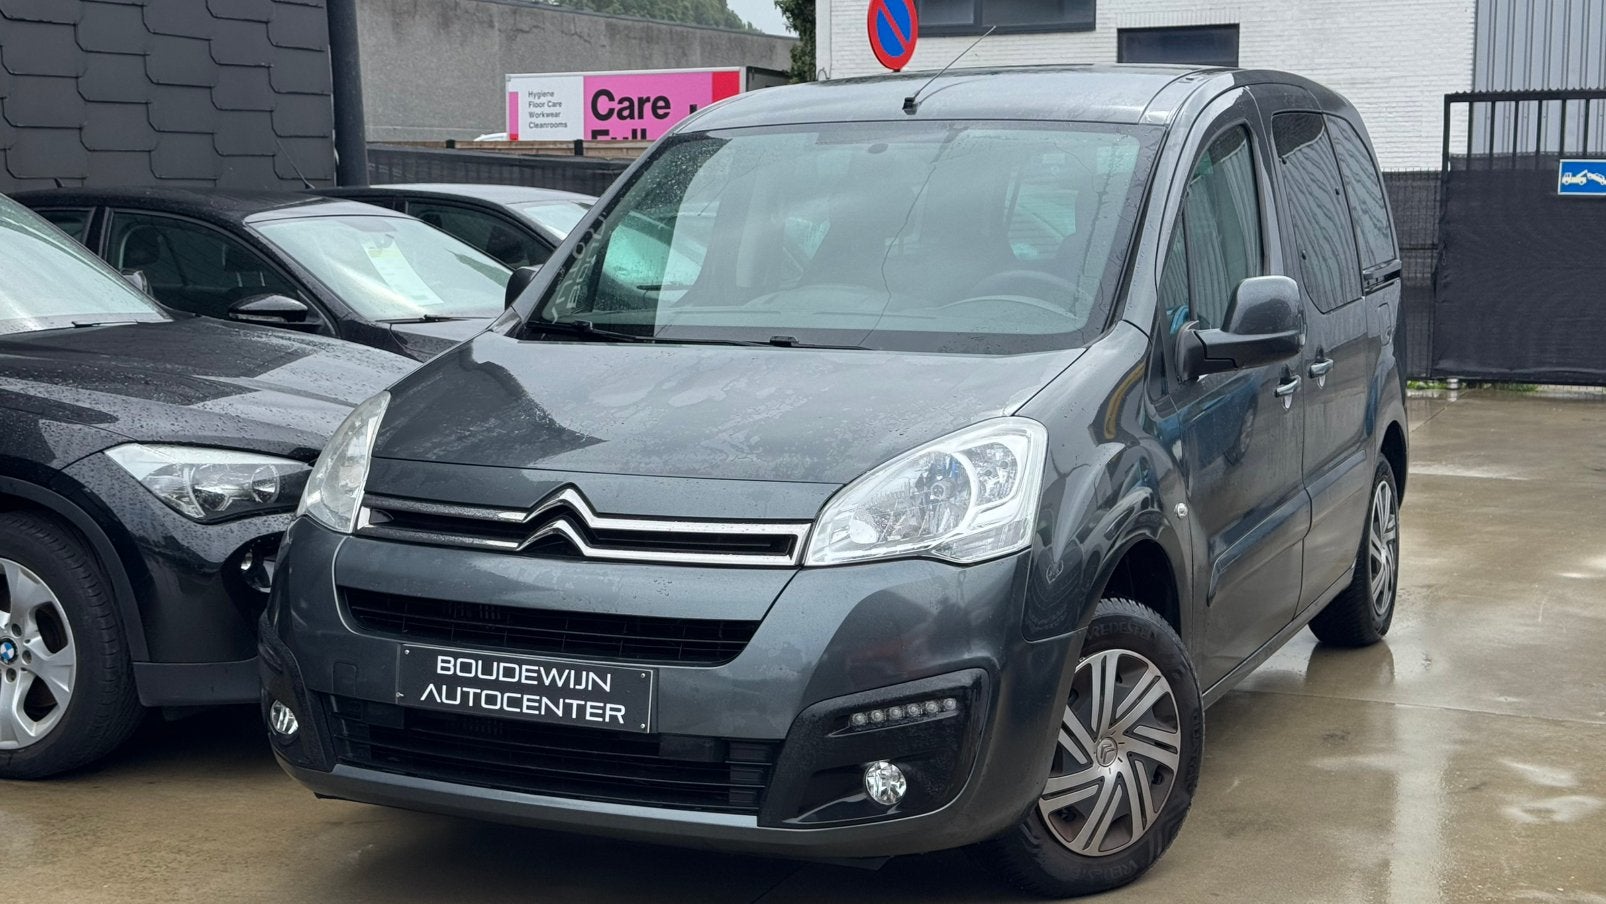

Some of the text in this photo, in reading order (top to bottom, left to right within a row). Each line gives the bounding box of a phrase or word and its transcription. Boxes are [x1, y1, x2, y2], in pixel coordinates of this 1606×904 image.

[528, 91, 554, 100] Hygiene
[547, 100, 562, 108] Care
[591, 89, 671, 121] Care
[529, 121, 568, 129] Cleanrooms
[436, 655, 612, 693] BOUDEWIJN
[420, 683, 626, 724] AUTOCENTER
